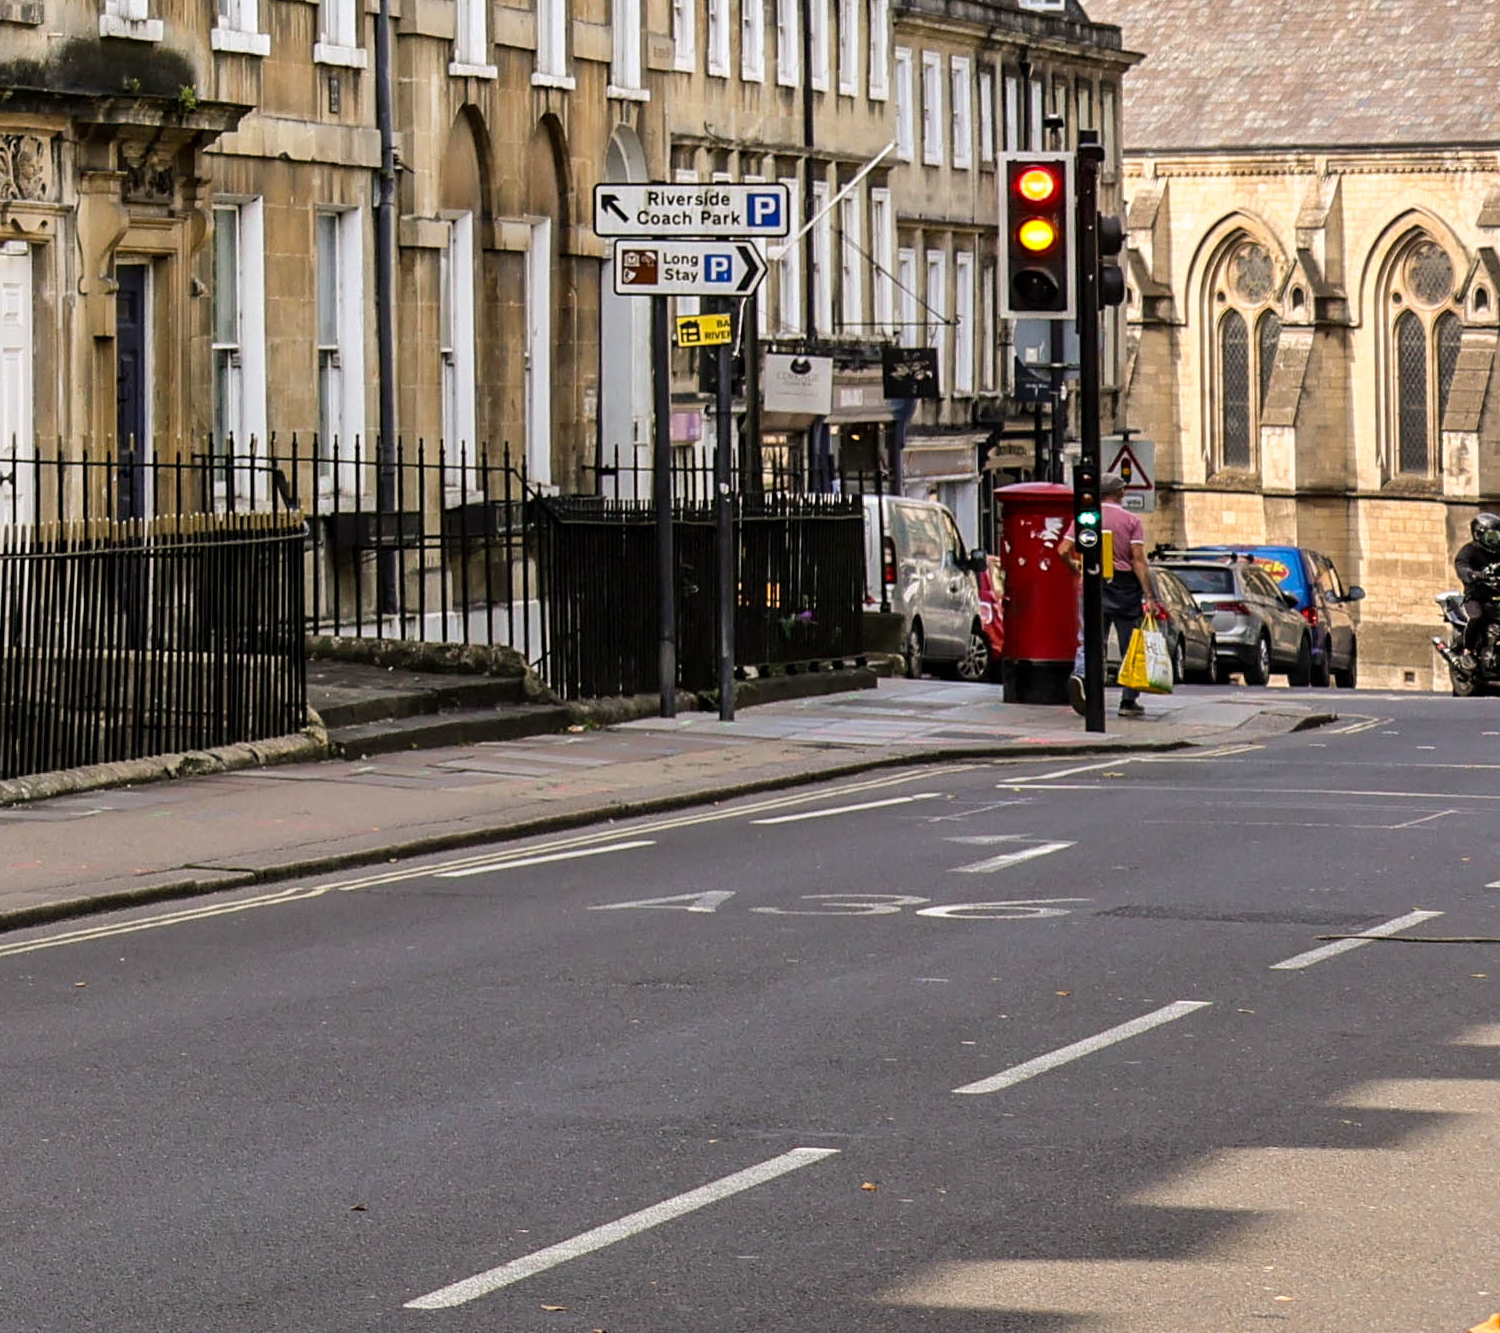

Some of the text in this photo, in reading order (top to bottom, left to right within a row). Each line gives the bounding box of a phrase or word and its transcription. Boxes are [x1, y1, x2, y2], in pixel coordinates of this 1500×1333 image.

[647, 191, 731, 206] Riverside
[636, 211, 741, 226] Coach Park
[663, 252, 699, 267] Long
[664, 268, 699, 283] Stay
